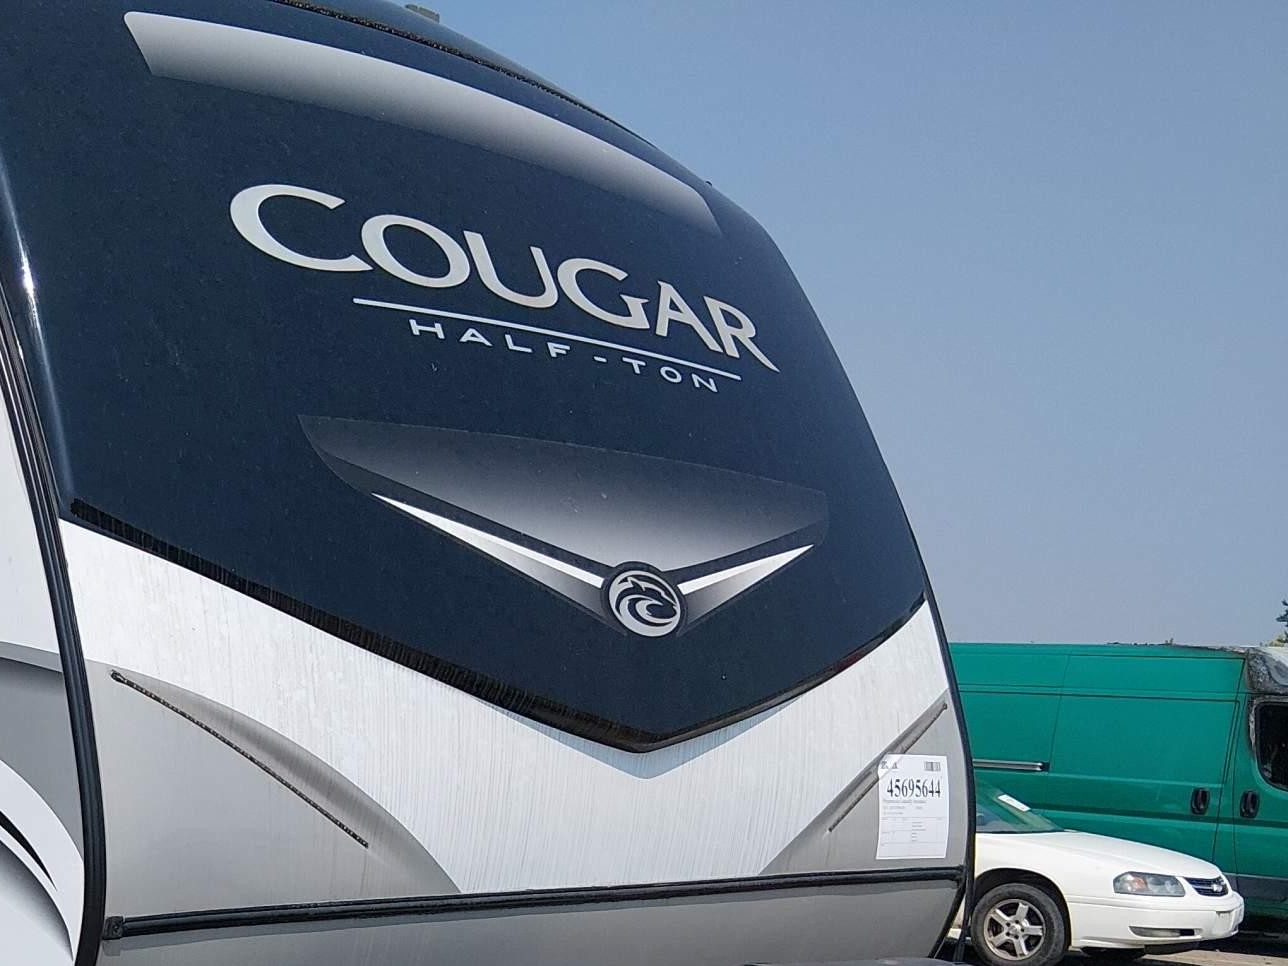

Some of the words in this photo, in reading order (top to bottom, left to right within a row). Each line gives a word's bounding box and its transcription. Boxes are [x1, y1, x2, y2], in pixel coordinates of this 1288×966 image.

[229, 183, 781, 374] COUGAR
[408, 318, 719, 394] HALF-TON
[886, 778, 941, 798] 45695644
